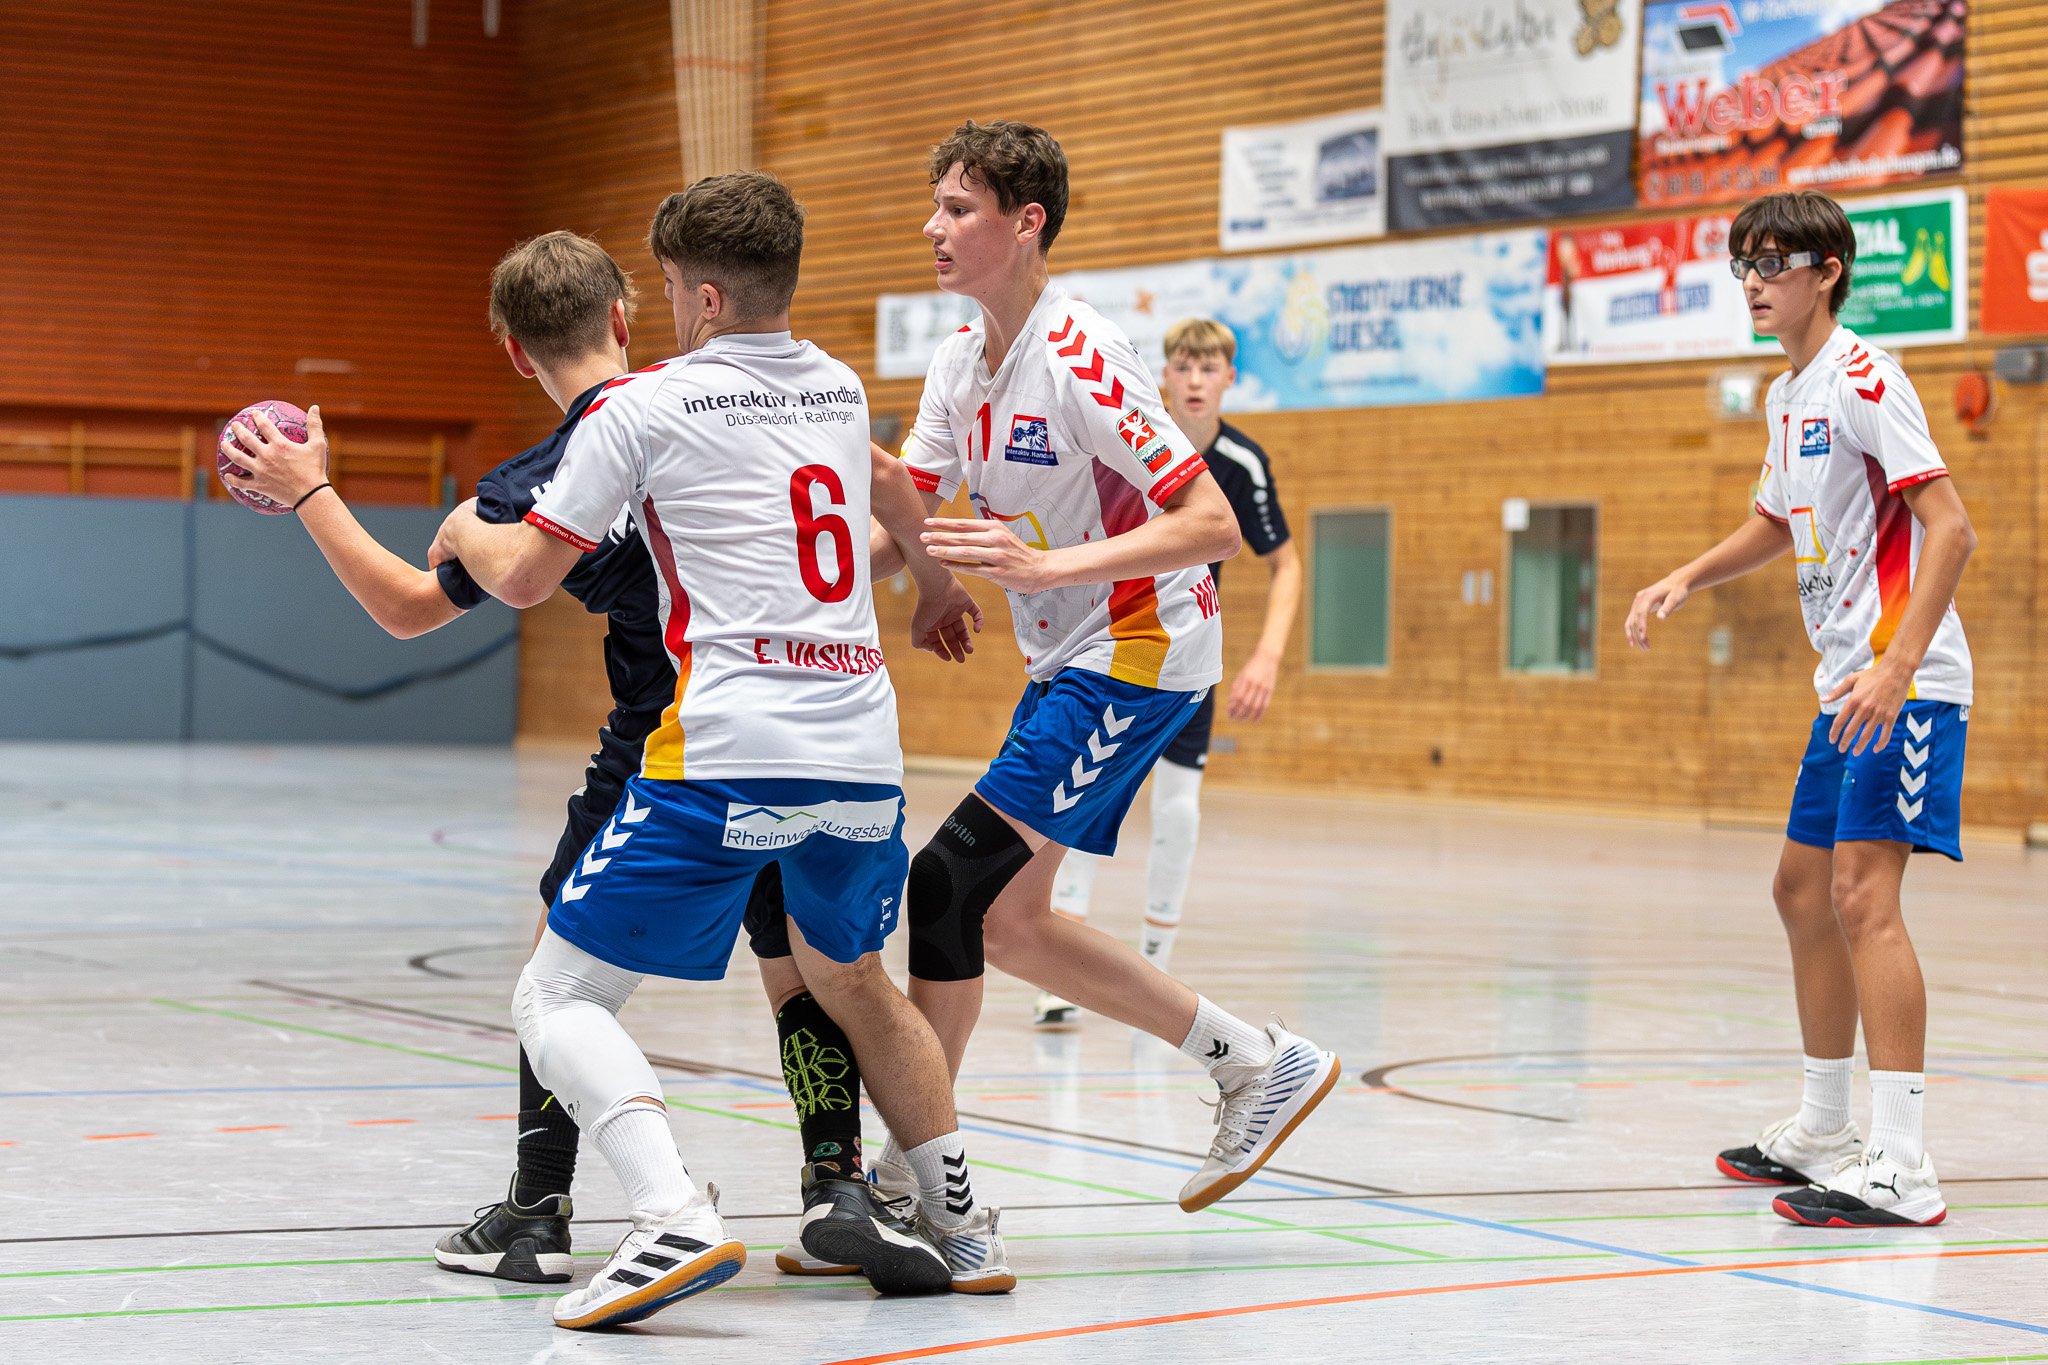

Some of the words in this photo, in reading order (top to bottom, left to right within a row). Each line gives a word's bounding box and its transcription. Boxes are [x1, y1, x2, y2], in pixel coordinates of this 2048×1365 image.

[1655, 69, 1849, 136] Weber
[682, 390, 787, 414] interaktiv
[543, 521, 569, 539] eröffnen
[789, 463, 856, 604] 6
[754, 638, 780, 664] E.
[944, 816, 976, 847] Gritin
